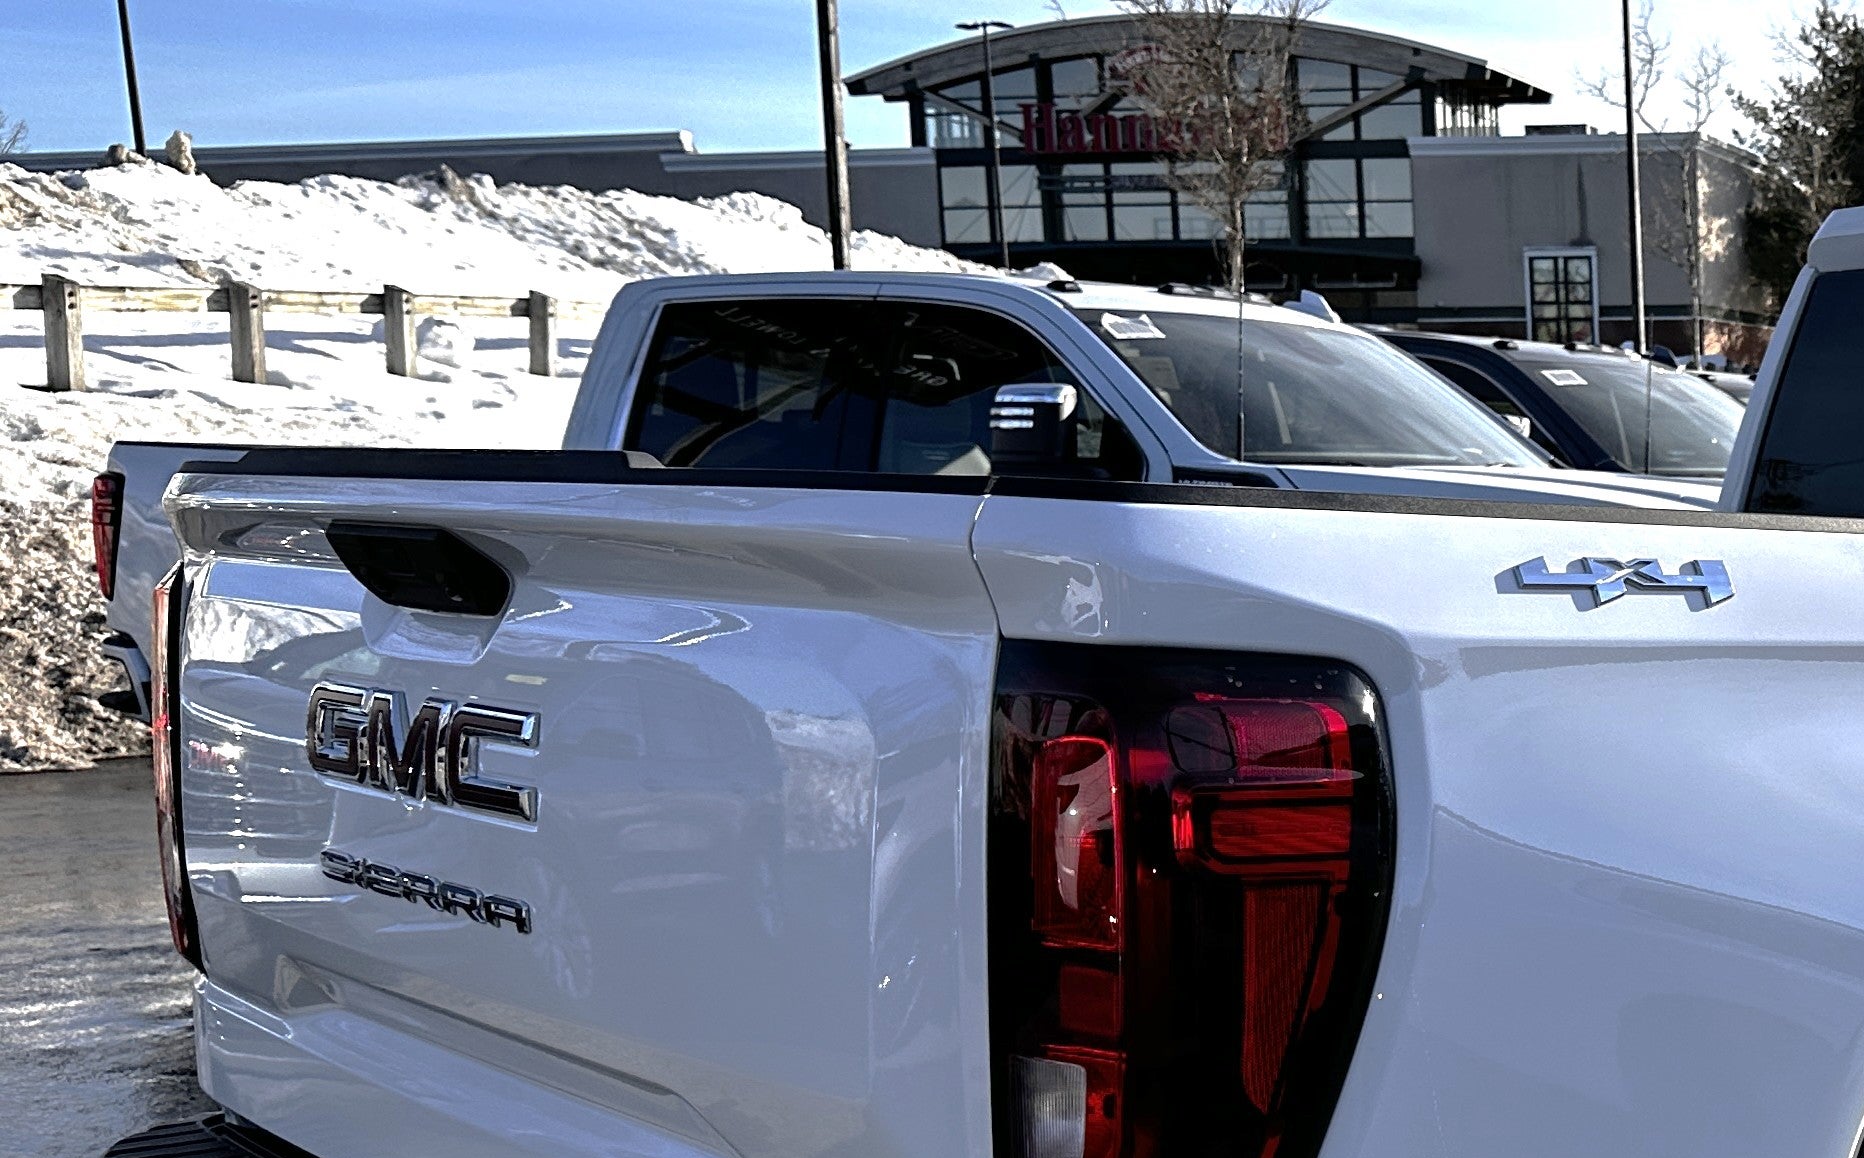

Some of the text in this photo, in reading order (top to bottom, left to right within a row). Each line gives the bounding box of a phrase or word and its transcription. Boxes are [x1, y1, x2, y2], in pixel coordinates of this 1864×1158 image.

[1019, 102, 1288, 155] Hannad
[306, 682, 541, 822] GMC
[320, 849, 532, 934] SIERRA
